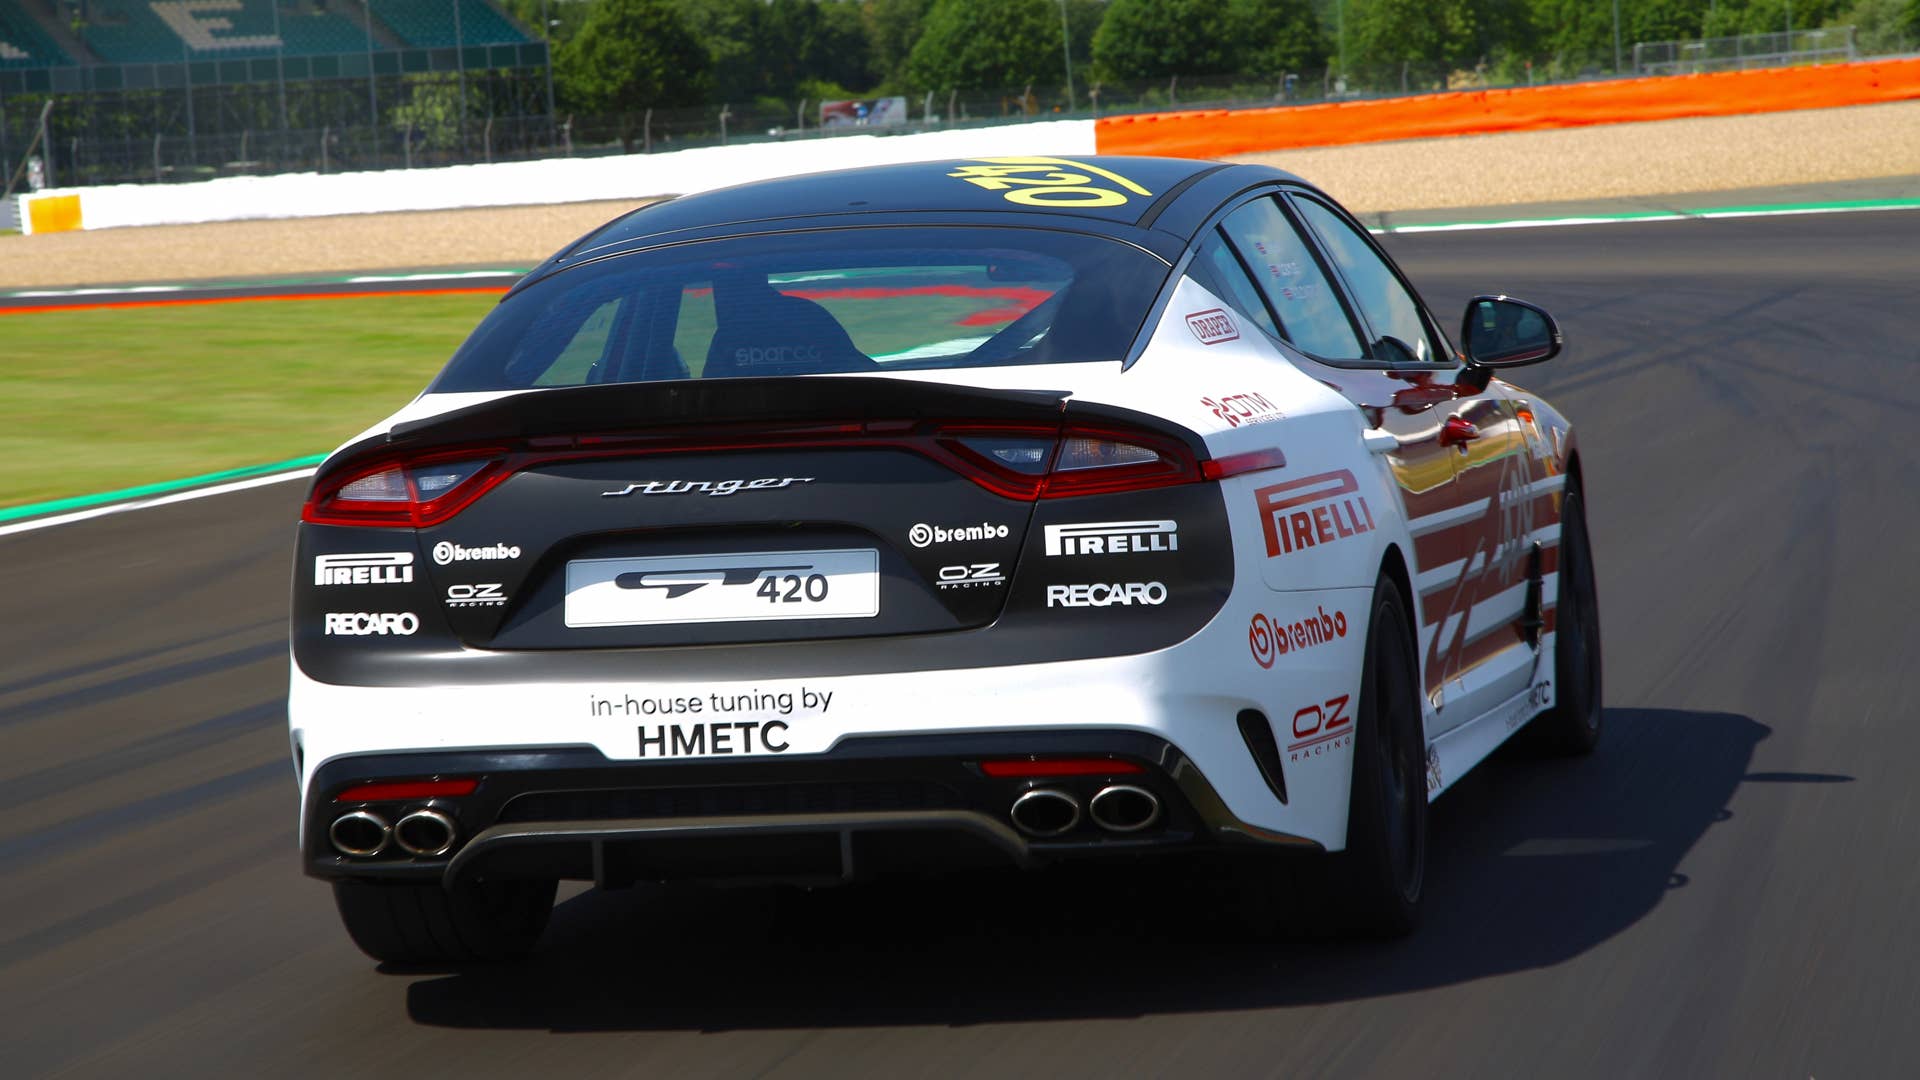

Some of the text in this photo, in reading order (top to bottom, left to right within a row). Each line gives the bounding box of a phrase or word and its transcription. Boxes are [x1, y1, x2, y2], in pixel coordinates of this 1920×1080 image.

[945, 165, 1129, 208] 420
[1191, 314, 1236, 340] DRAPER
[601, 476, 816, 497] stinger
[1254, 468, 1376, 558] PIRELLI
[934, 522, 1009, 544] brembo
[1044, 519, 1178, 556] PIRELLI
[454, 543, 521, 562] brembo
[314, 551, 415, 586] PIRELLI
[756, 573, 829, 604] 420
[941, 580, 1002, 590] RACING
[1047, 580, 1168, 608] RECARO
[325, 611, 420, 636] RECARO
[1273, 605, 1348, 655] brembo
[590, 686, 834, 717] in-house tuning by
[637, 719, 791, 757] HMETC
[1290, 737, 1351, 762] RACING
